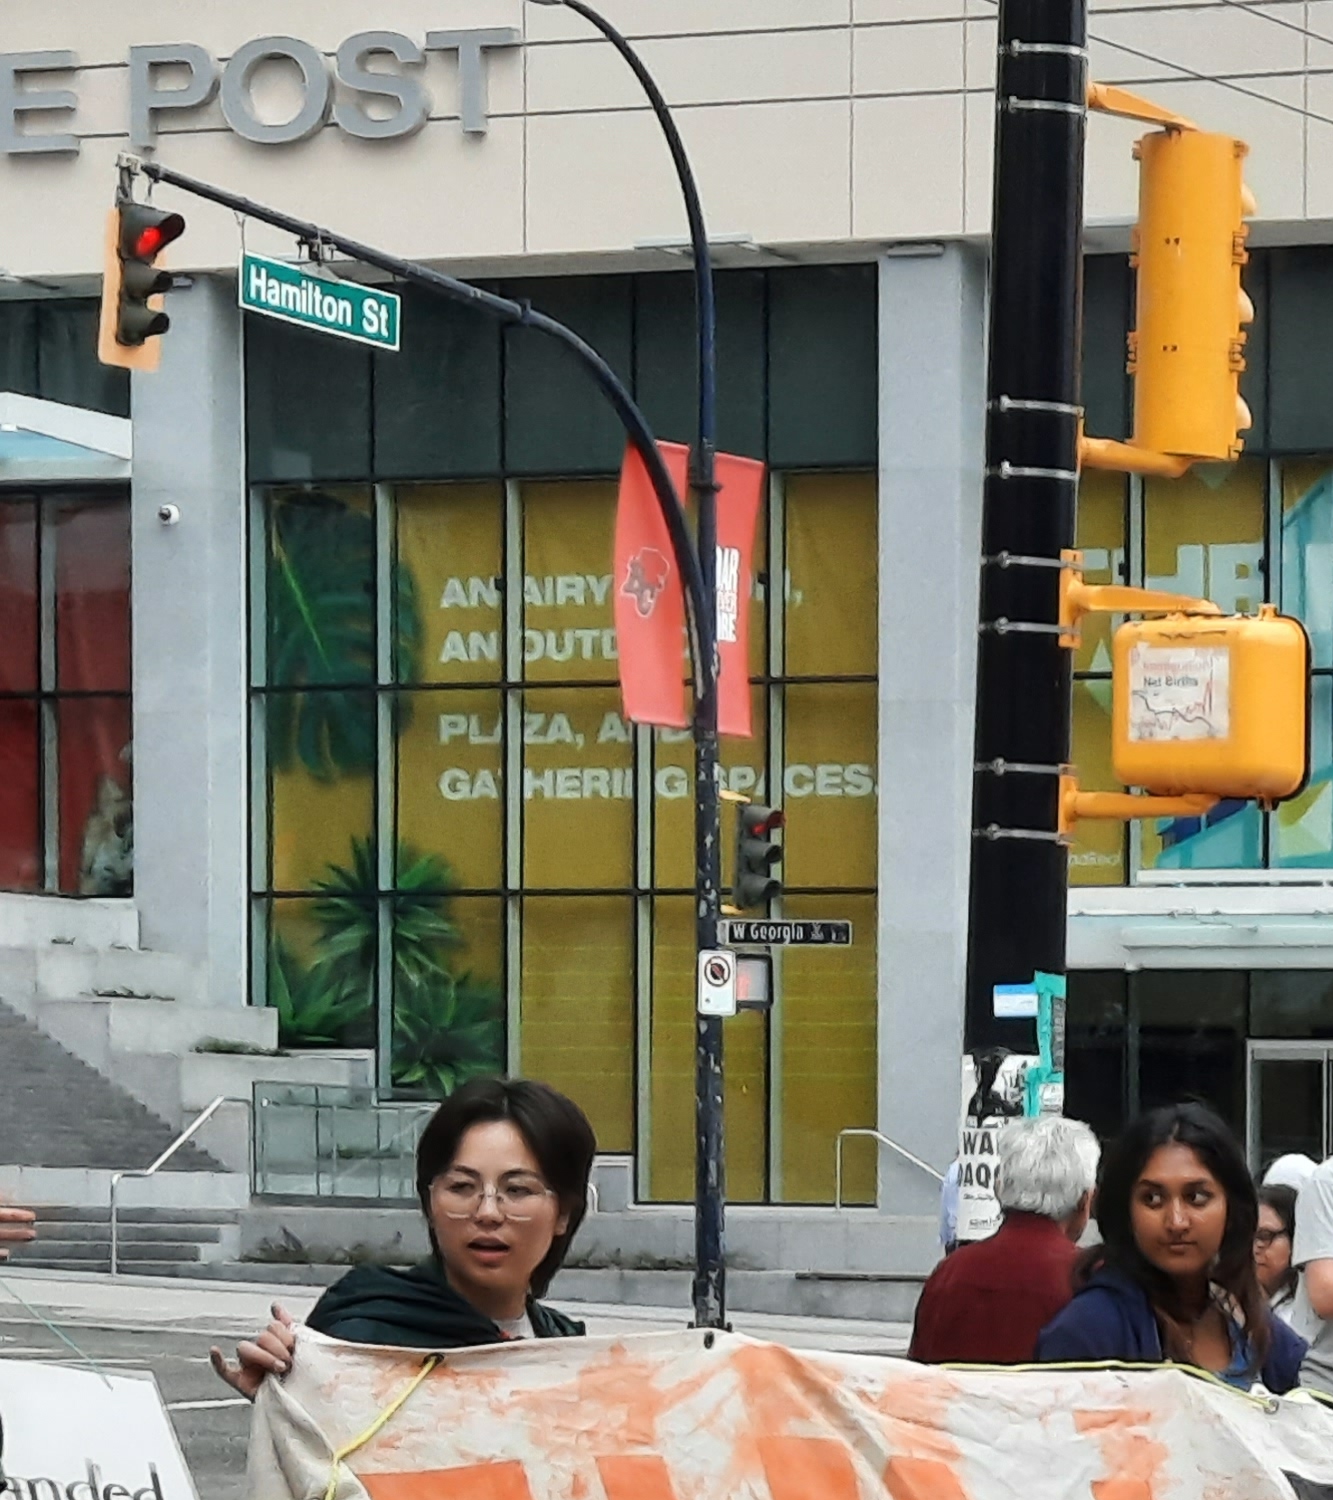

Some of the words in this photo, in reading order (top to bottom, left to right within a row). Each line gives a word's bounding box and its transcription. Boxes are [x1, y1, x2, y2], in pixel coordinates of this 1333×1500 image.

[128, 27, 528, 152] POST
[250, 264, 352, 327] Hamilton
[362, 298, 389, 338] St
[440, 576, 500, 608] AN
[523, 574, 614, 607] AIRY
[439, 630, 500, 663] AN
[438, 764, 688, 801] GAHERIG
[733, 922, 745, 940] W
[749, 922, 804, 945] Georgia
[962, 1131, 999, 1155] WA
